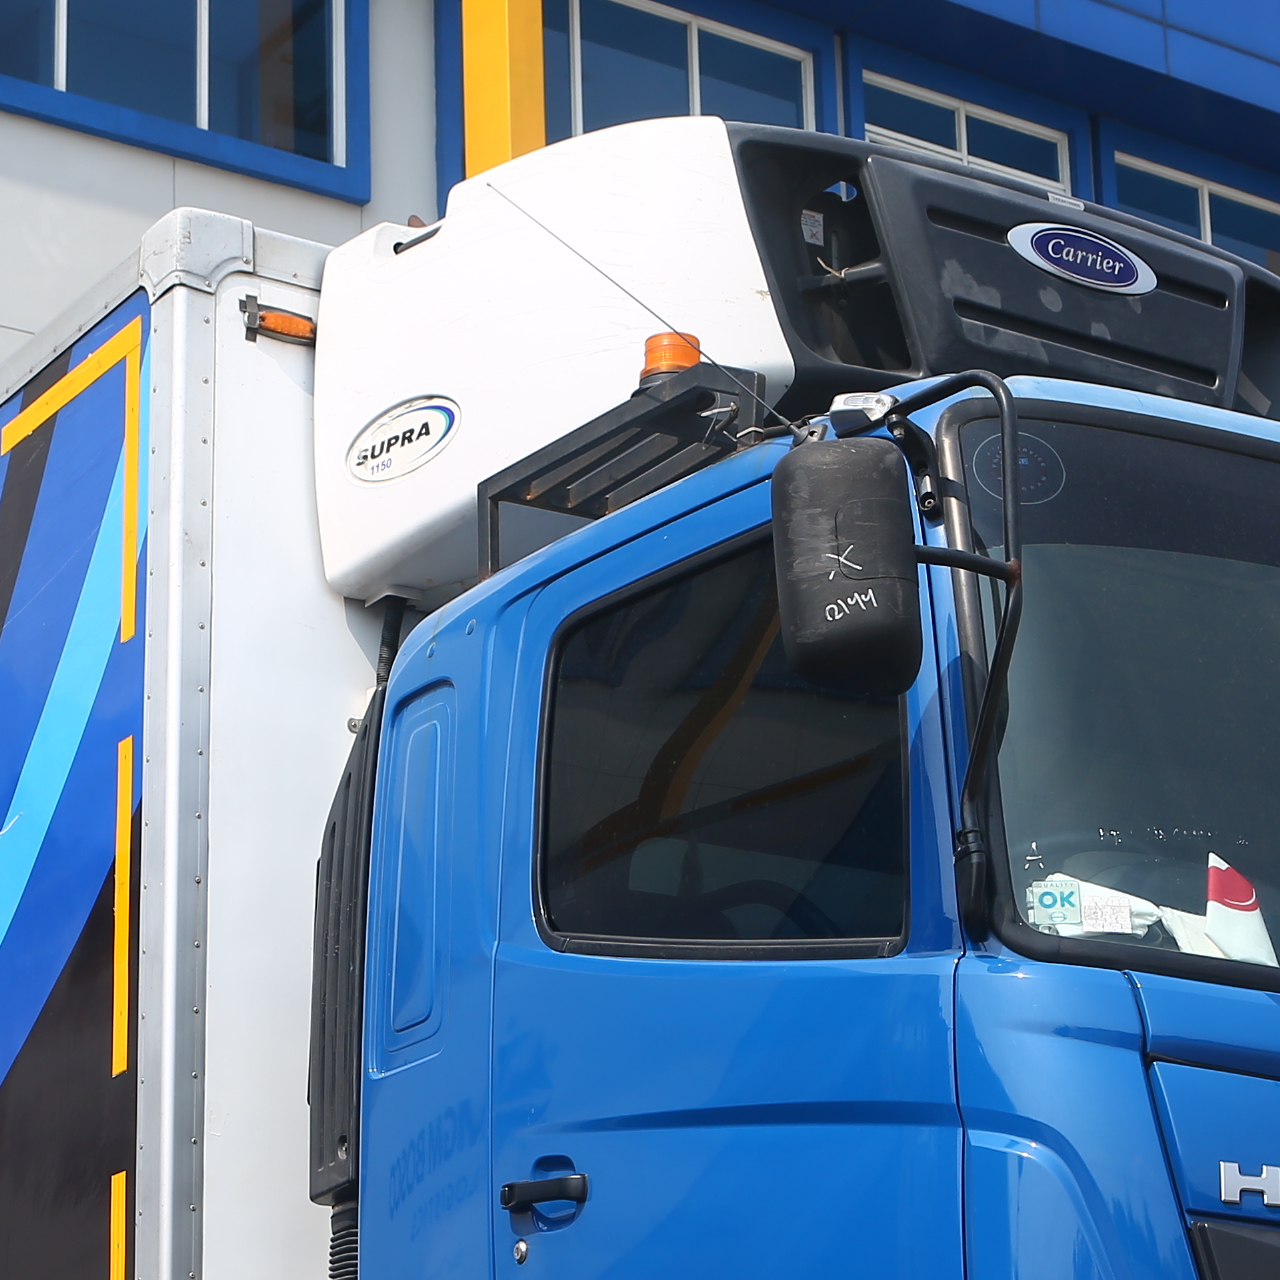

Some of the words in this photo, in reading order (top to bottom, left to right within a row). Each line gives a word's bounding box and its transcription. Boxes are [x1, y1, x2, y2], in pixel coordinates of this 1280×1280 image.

[1048, 238, 1124, 275] Carrier
[356, 421, 430, 467] SUPRA
[370, 458, 392, 476] 1150
[1038, 891, 1075, 908] OK
